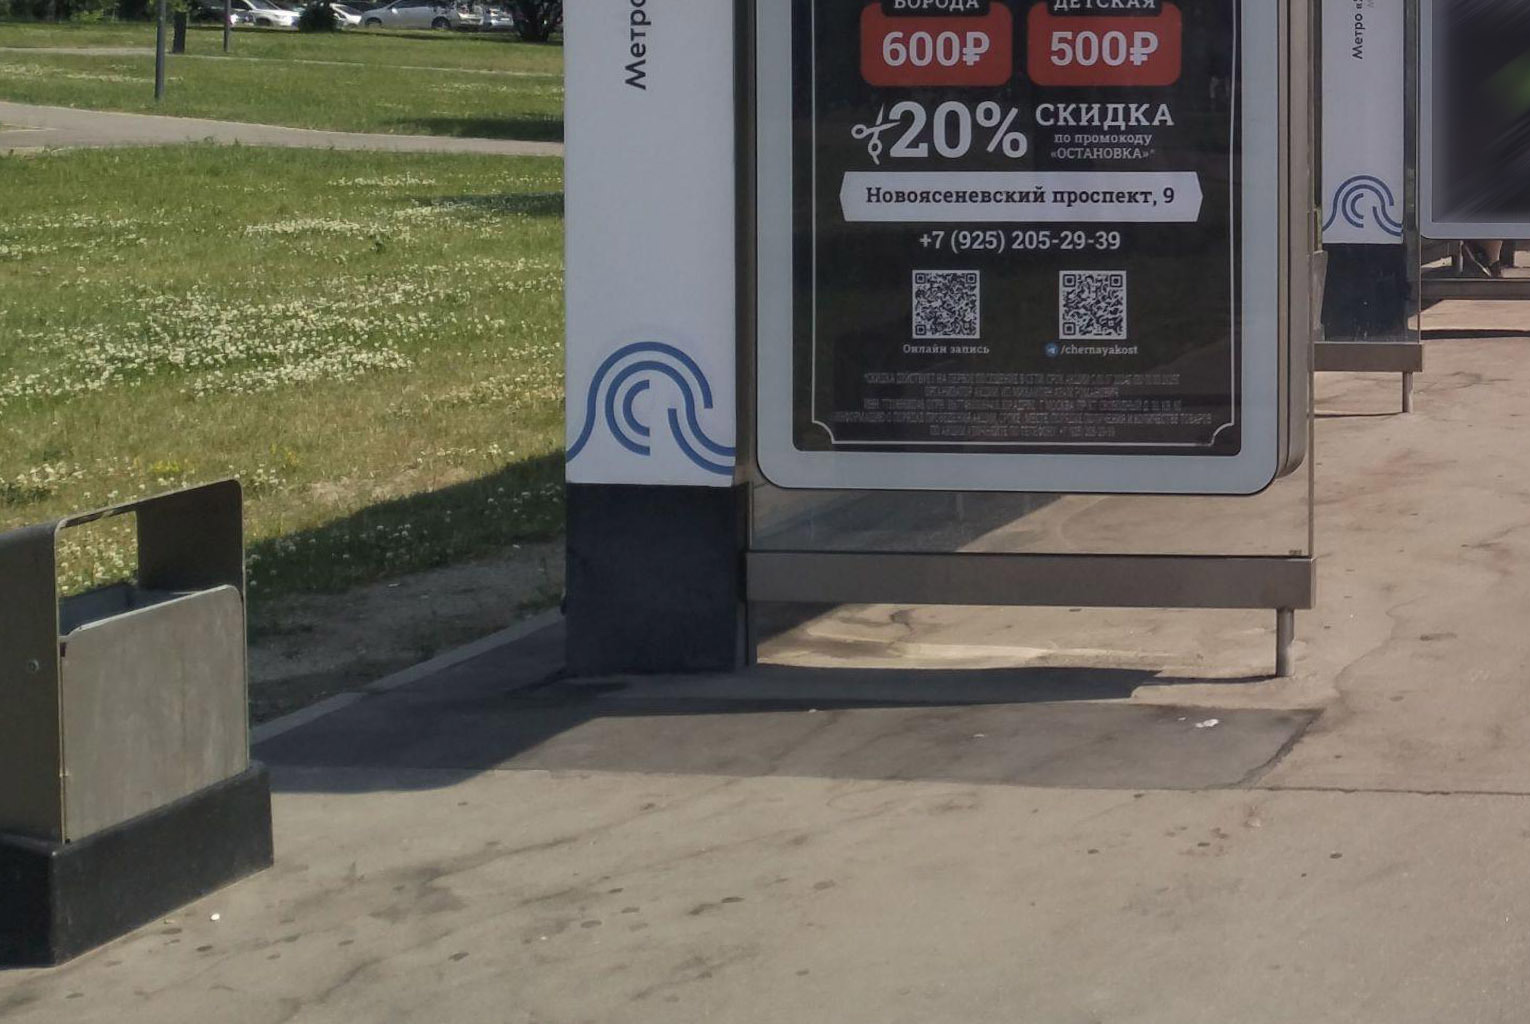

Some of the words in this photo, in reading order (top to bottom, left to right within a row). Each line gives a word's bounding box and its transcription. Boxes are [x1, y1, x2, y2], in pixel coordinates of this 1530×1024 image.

[882, 30, 990, 67] 600₽
[1050, 30, 1159, 67] 500₽
[1352, 12, 1366, 60] Метро
[888, 100, 1028, 159] 20%
[1035, 102, 1175, 131] СКИДКА
[1054, 134, 1071, 143] по
[1074, 133, 1153, 146] промокоду
[865, 186, 1046, 204] Новоясеневский
[1051, 188, 1158, 207] проспект,
[1162, 187, 1175, 204] 9
[919, 230, 946, 250] +7
[950, 229, 1006, 255] (925)
[1011, 230, 1121, 250] 205-29-39
[902, 343, 947, 355] Онлайн
[950, 345, 990, 355] запись
